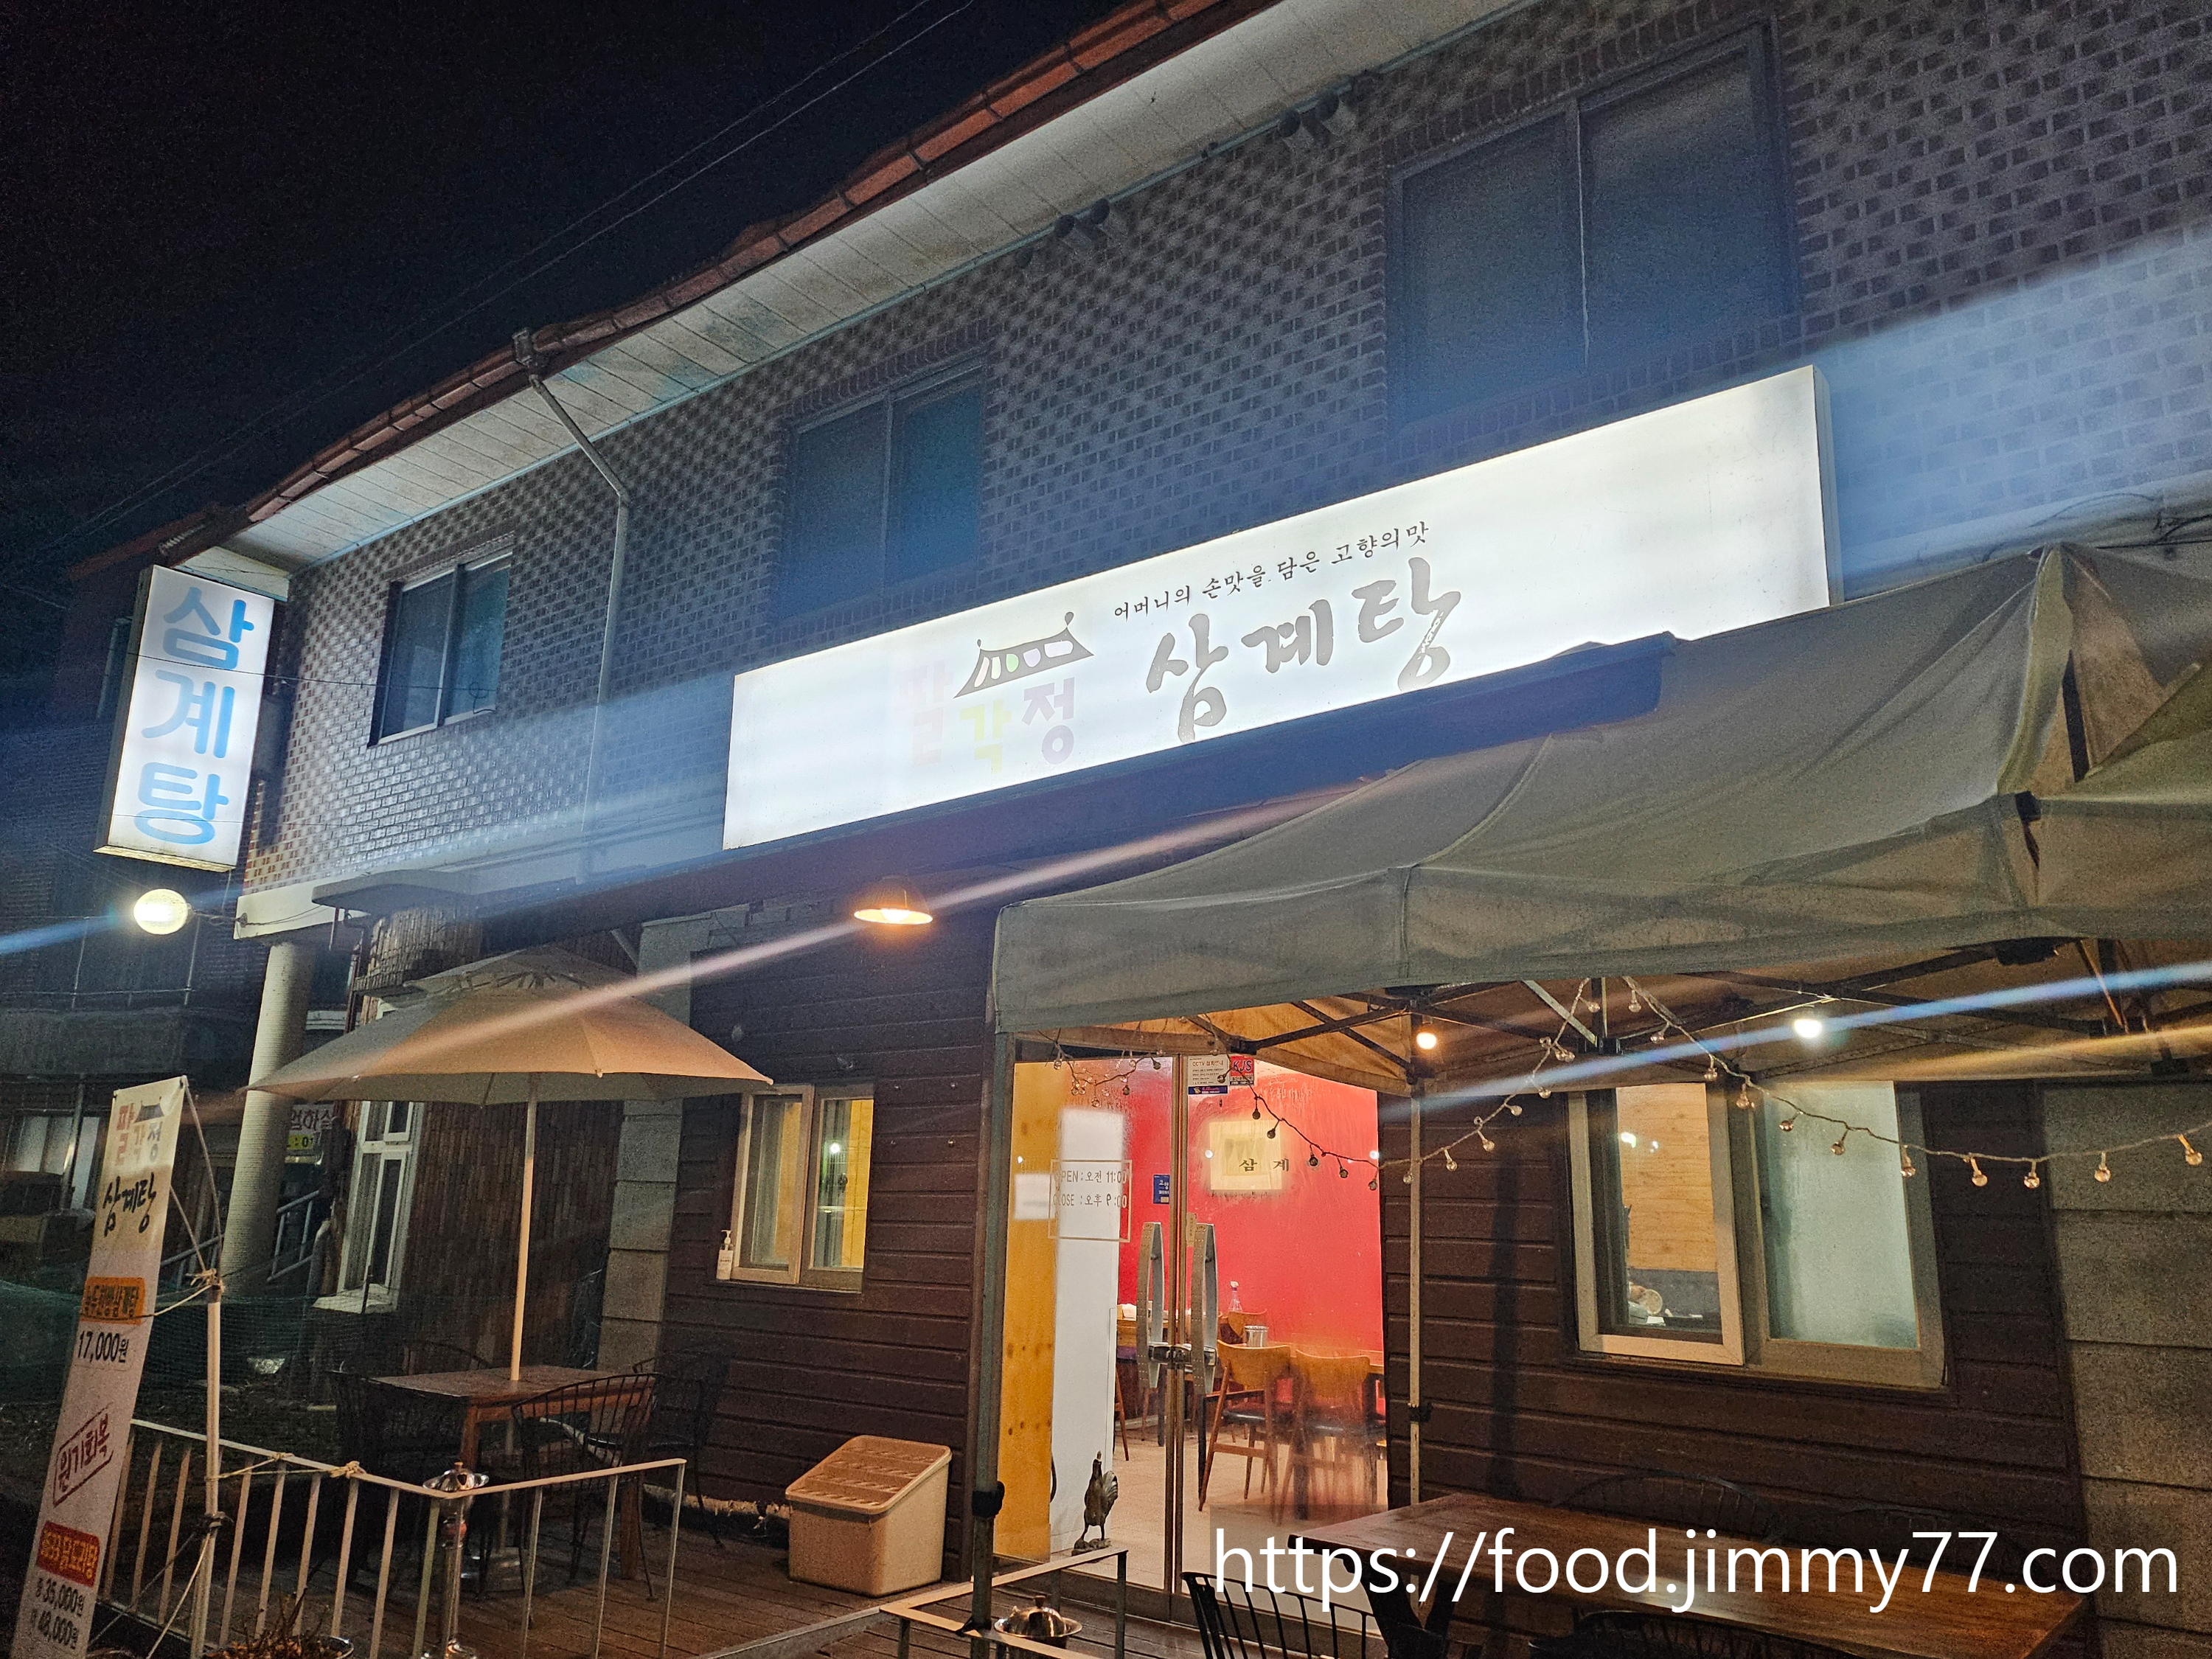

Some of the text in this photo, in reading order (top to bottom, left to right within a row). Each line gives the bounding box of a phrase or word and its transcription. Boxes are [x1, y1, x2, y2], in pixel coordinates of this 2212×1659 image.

[1114, 585, 1191, 623] 어머니의
[1277, 551, 1320, 581] 담은
[1146, 557, 1461, 742] 삼계탕
[133, 586, 254, 845] 삼계탕
[1233, 1060, 1252, 1072] KJS
[115, 1102, 163, 1166] 팔각정
[102, 1171, 156, 1237] 삼계탕
[1085, 1170, 1102, 1183] 오전
[1106, 1171, 1128, 1184] 11:00
[1085, 1194, 1102, 1207] 오후
[77, 1330, 129, 1363] 17,000원
[58, 1413, 110, 1492] 원기회복
